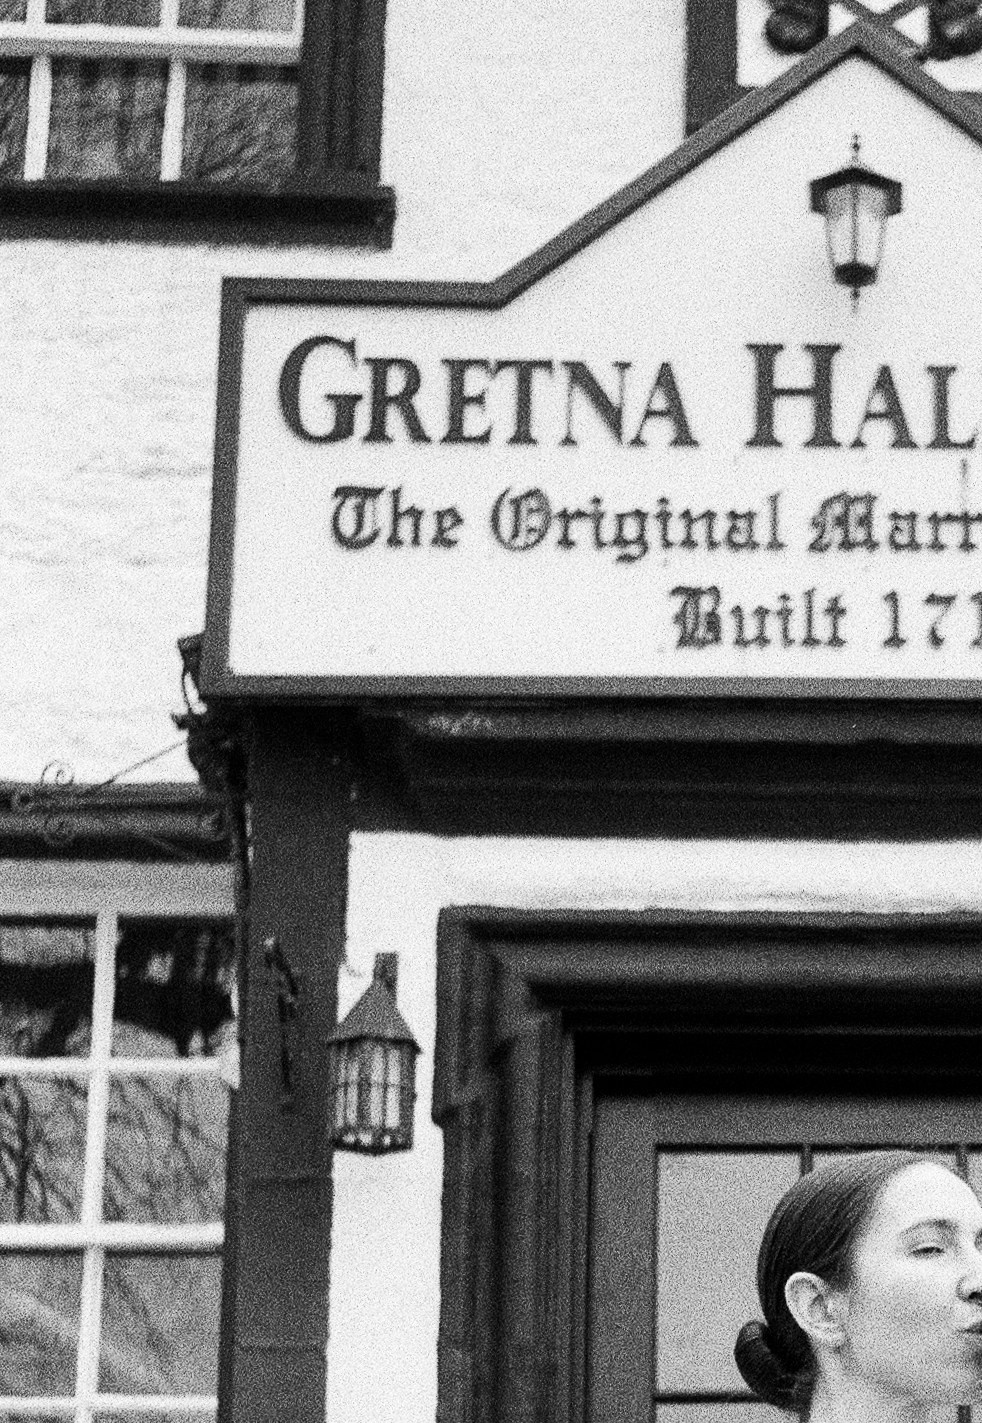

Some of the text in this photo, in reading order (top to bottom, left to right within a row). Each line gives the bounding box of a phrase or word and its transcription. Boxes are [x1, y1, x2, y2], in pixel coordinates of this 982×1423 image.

[278, 335, 699, 448] GRETNA
[331, 485, 464, 551] The
[490, 488, 786, 564] Original
[669, 585, 846, 650] Built
